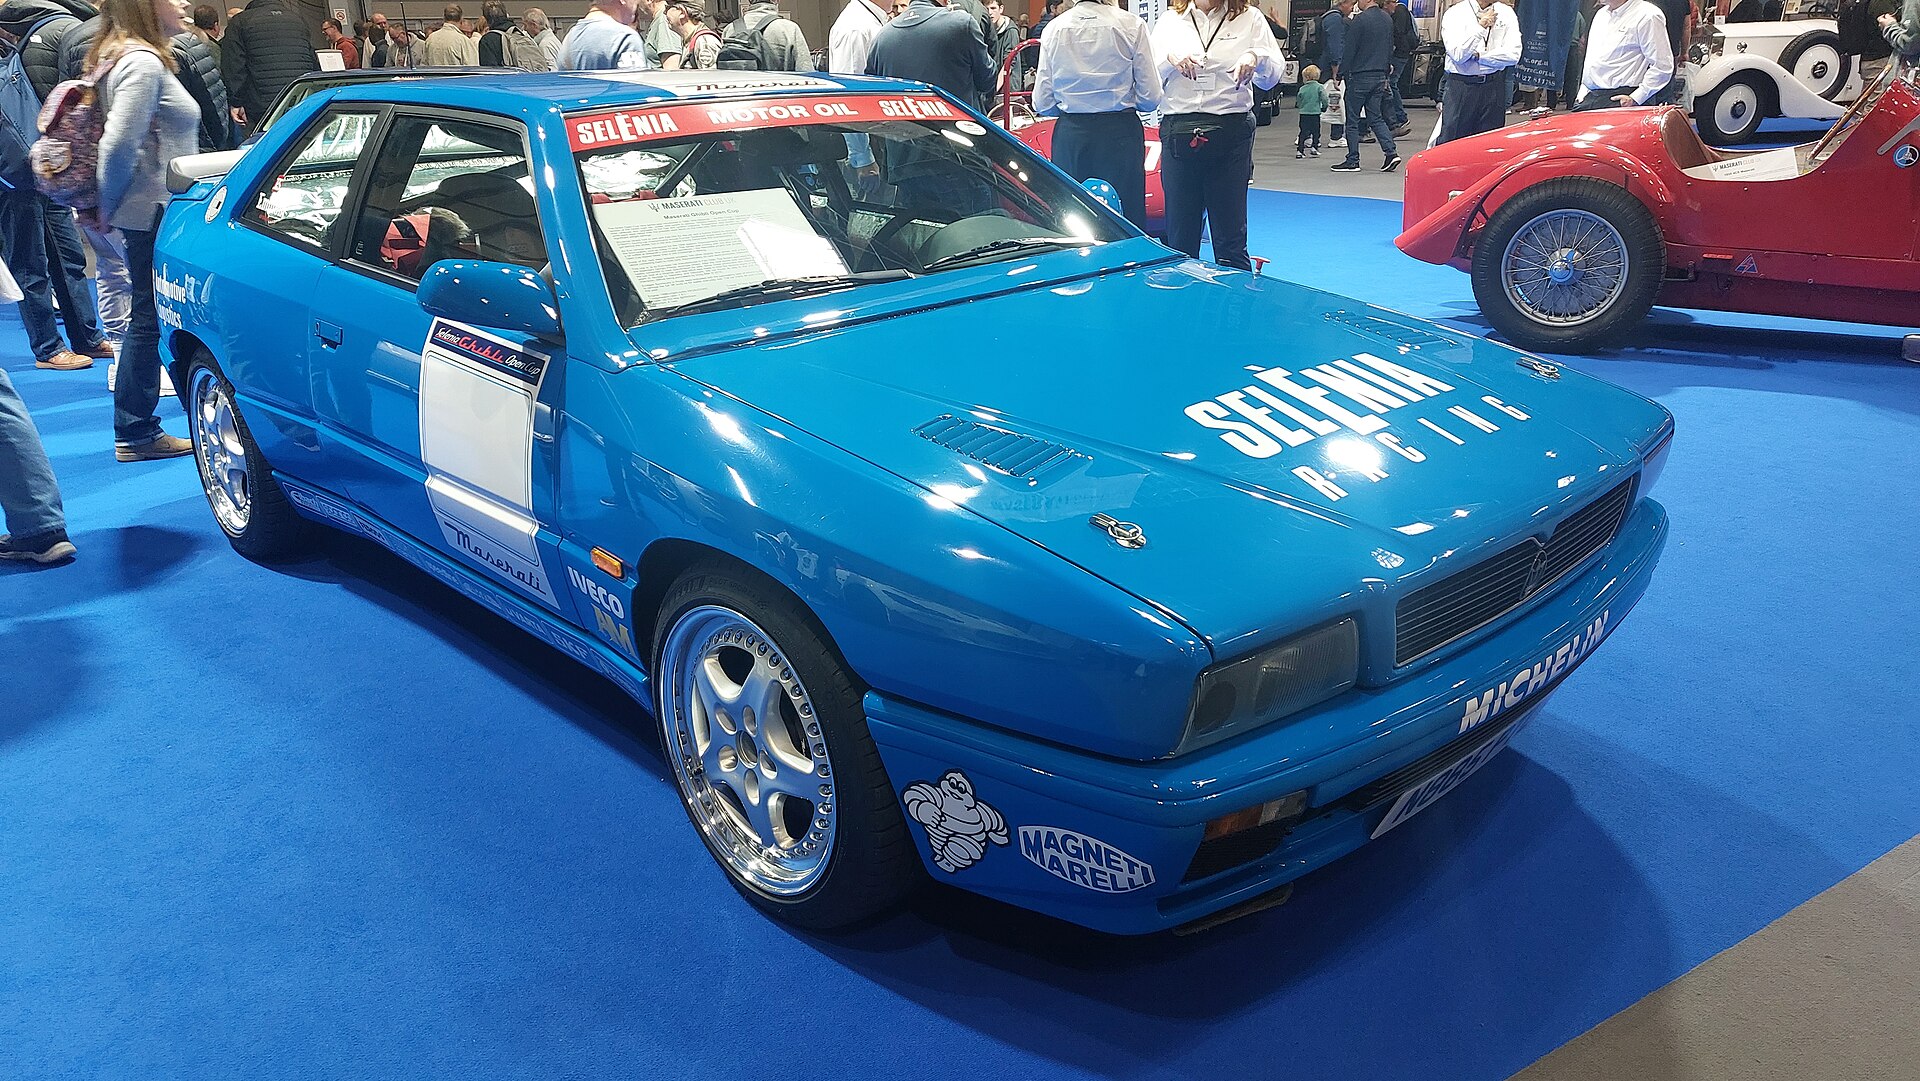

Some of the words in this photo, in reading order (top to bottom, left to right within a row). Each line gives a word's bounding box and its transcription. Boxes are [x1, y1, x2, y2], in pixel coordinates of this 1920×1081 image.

[675, 80, 827, 91] Maserati
[576, 112, 680, 145] SELÈNIA
[707, 105, 811, 125] MOTOR
[813, 103, 859, 117] OIL
[1719, 161, 1743, 170] MASERATI
[661, 200, 704, 210] MASERATI
[704, 197, 724, 206] CLUB
[664, 212, 690, 220] Maserati
[434, 327, 461, 345] Selenia
[458, 336, 505, 364] Ghibli
[505, 354, 525, 370] Open
[524, 361, 541, 376] Cup
[1184, 353, 1457, 460] SELÈNIA
[1290, 395, 1533, 502] RCING
[444, 521, 547, 596] Maserati
[567, 565, 625, 619] IVECO
[1458, 609, 1609, 734] MICHELIN
[1022, 829, 1152, 885] MAGNETI
[1023, 848, 1151, 891] MARELLI
